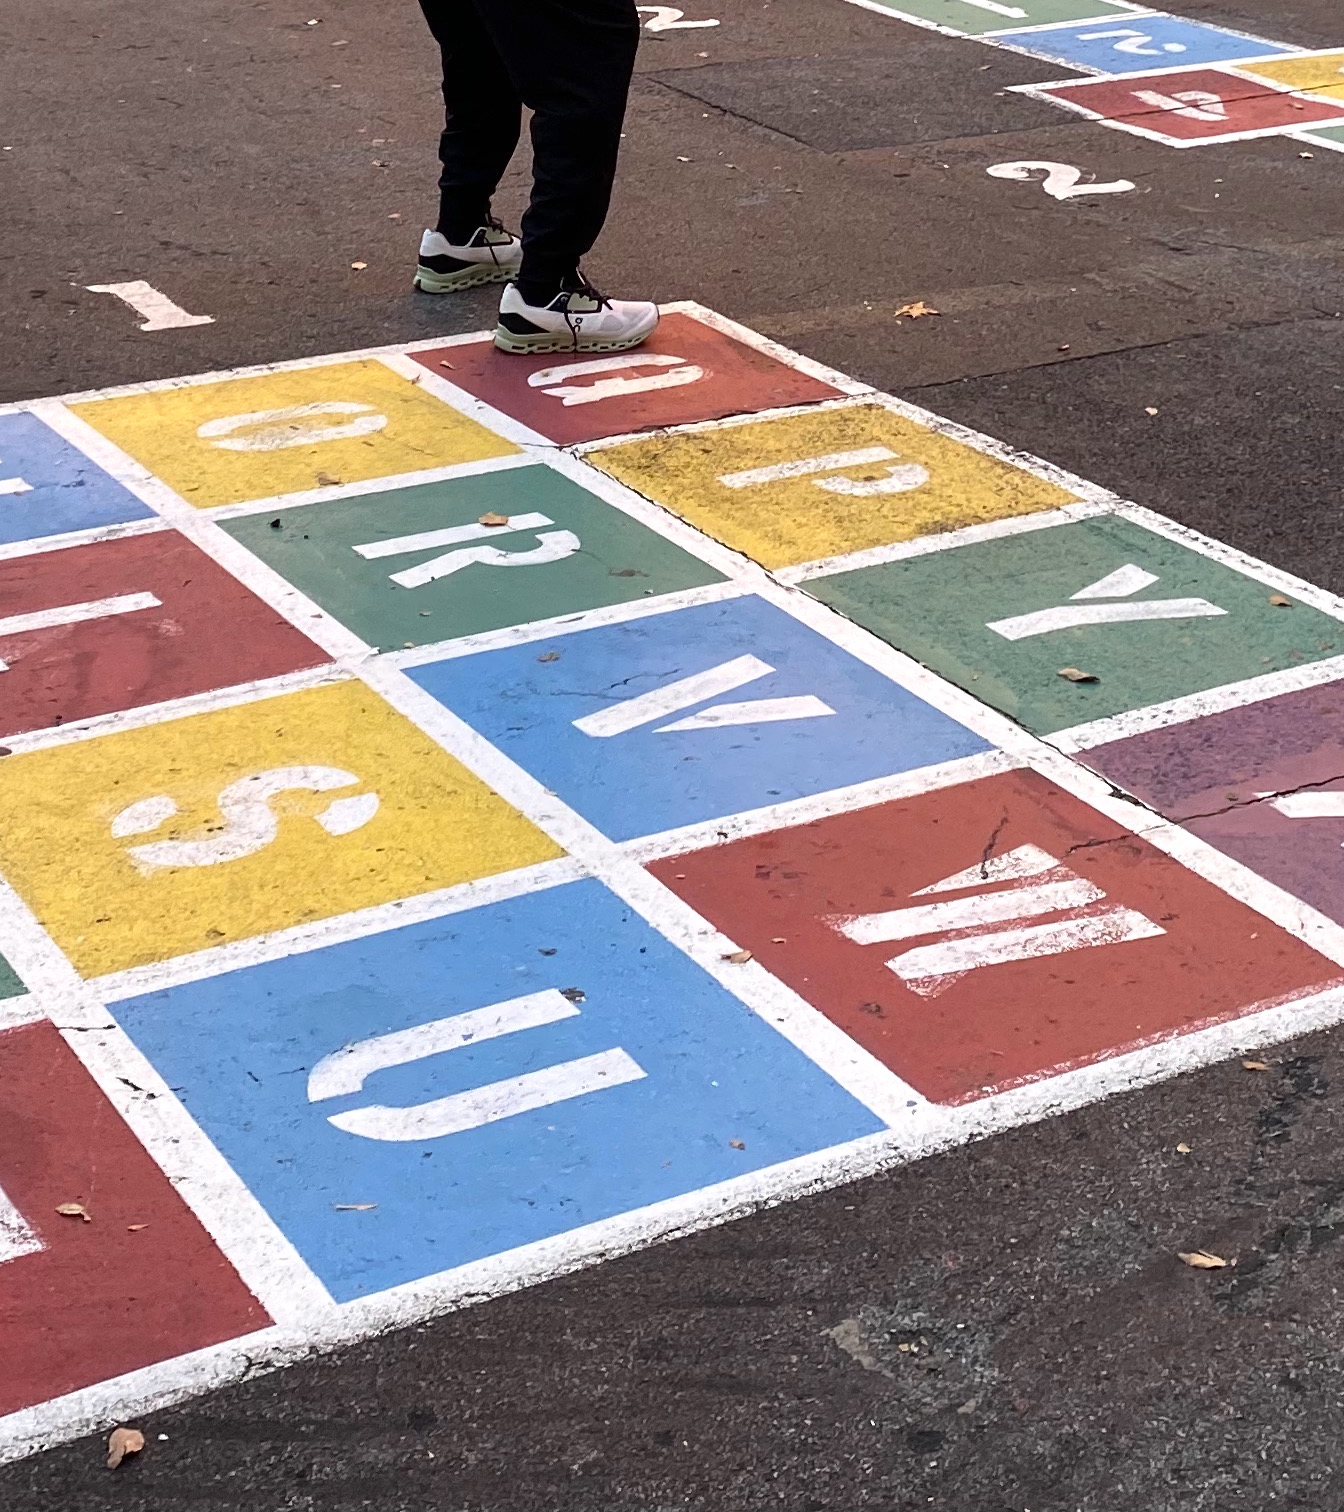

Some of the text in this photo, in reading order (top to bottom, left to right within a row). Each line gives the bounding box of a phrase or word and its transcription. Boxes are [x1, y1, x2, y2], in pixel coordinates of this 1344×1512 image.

[1077, 29, 1187, 55] 2
[985, 160, 1137, 200] 2
[86, 279, 217, 332] 1
[527, 353, 705, 407] Q
[197, 401, 388, 452] O
[720, 446, 929, 497] P
[351, 511, 582, 589] R
[985, 563, 1229, 641] Y
[572, 653, 837, 738] V
[110, 765, 381, 871] S
[828, 843, 1167, 984] W
[306, 987, 649, 1143] U
